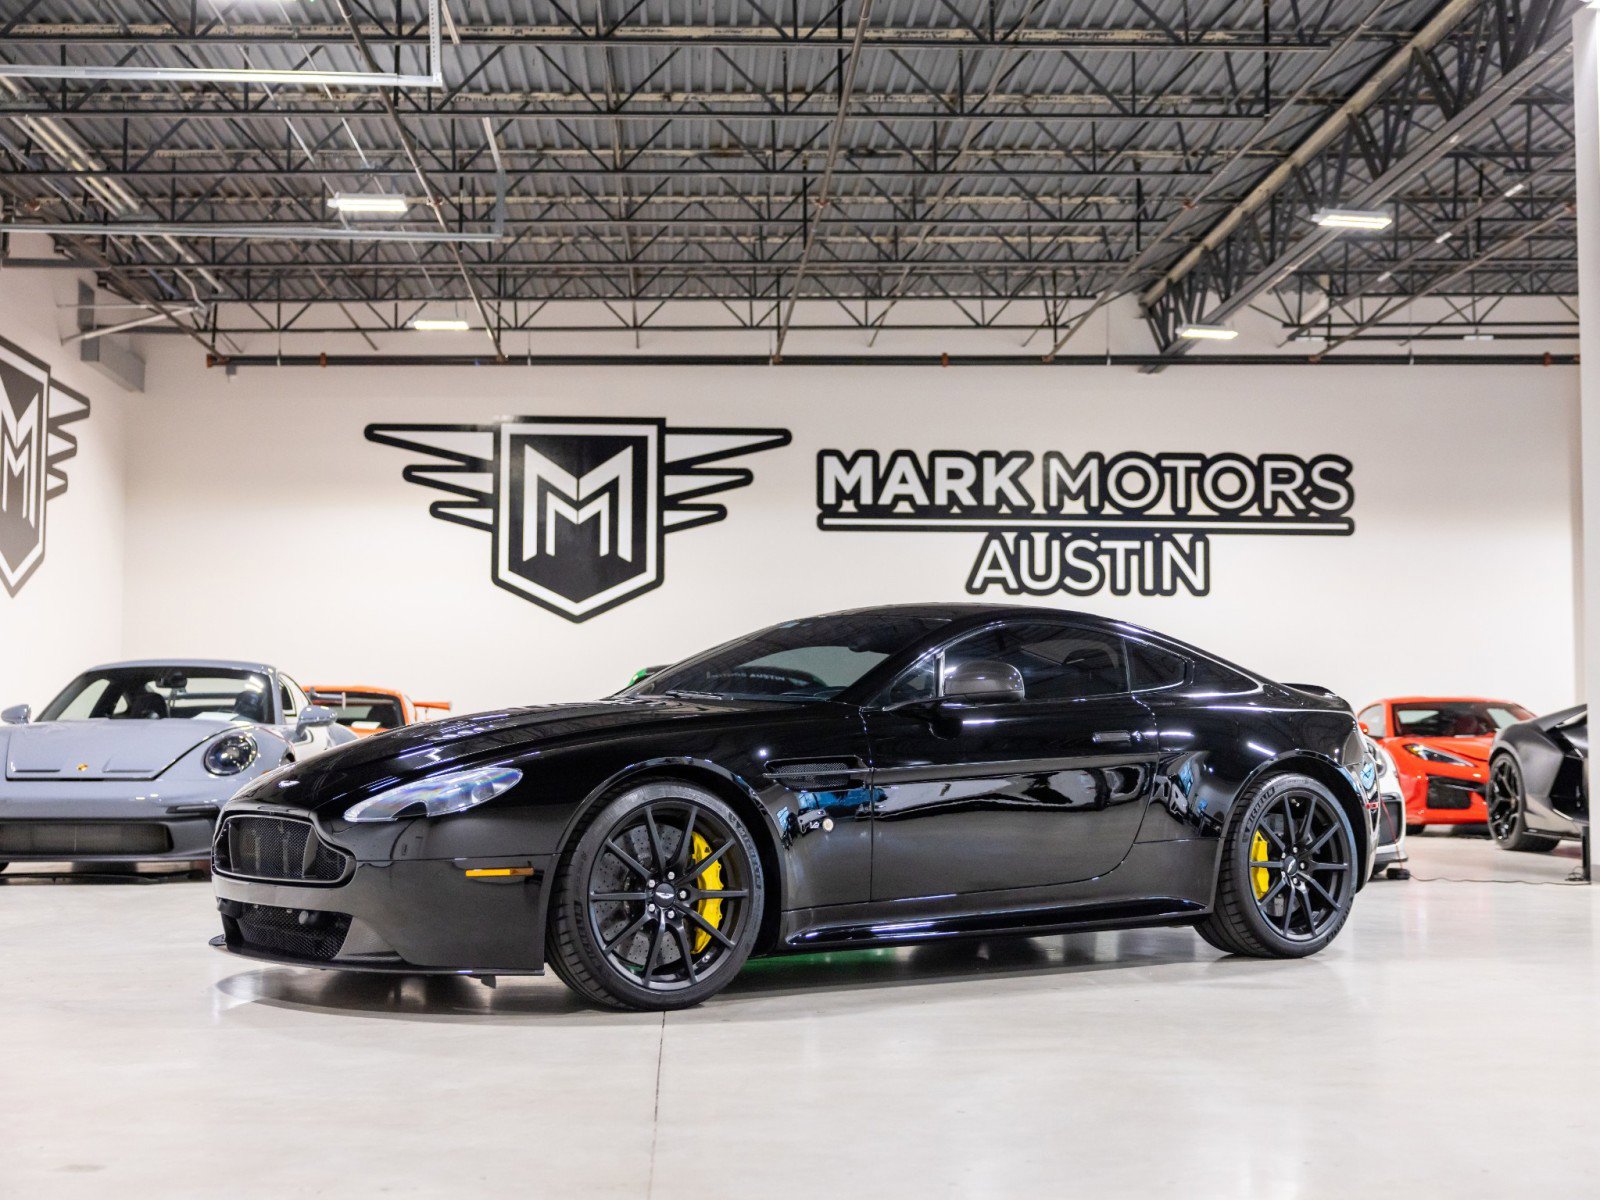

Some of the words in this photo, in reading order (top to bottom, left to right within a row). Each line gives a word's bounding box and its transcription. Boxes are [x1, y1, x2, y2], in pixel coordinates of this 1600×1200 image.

[822, 454, 1032, 507] MARK
[1048, 457, 1349, 512] MOTORS
[971, 538, 1205, 592] AUSTIN
